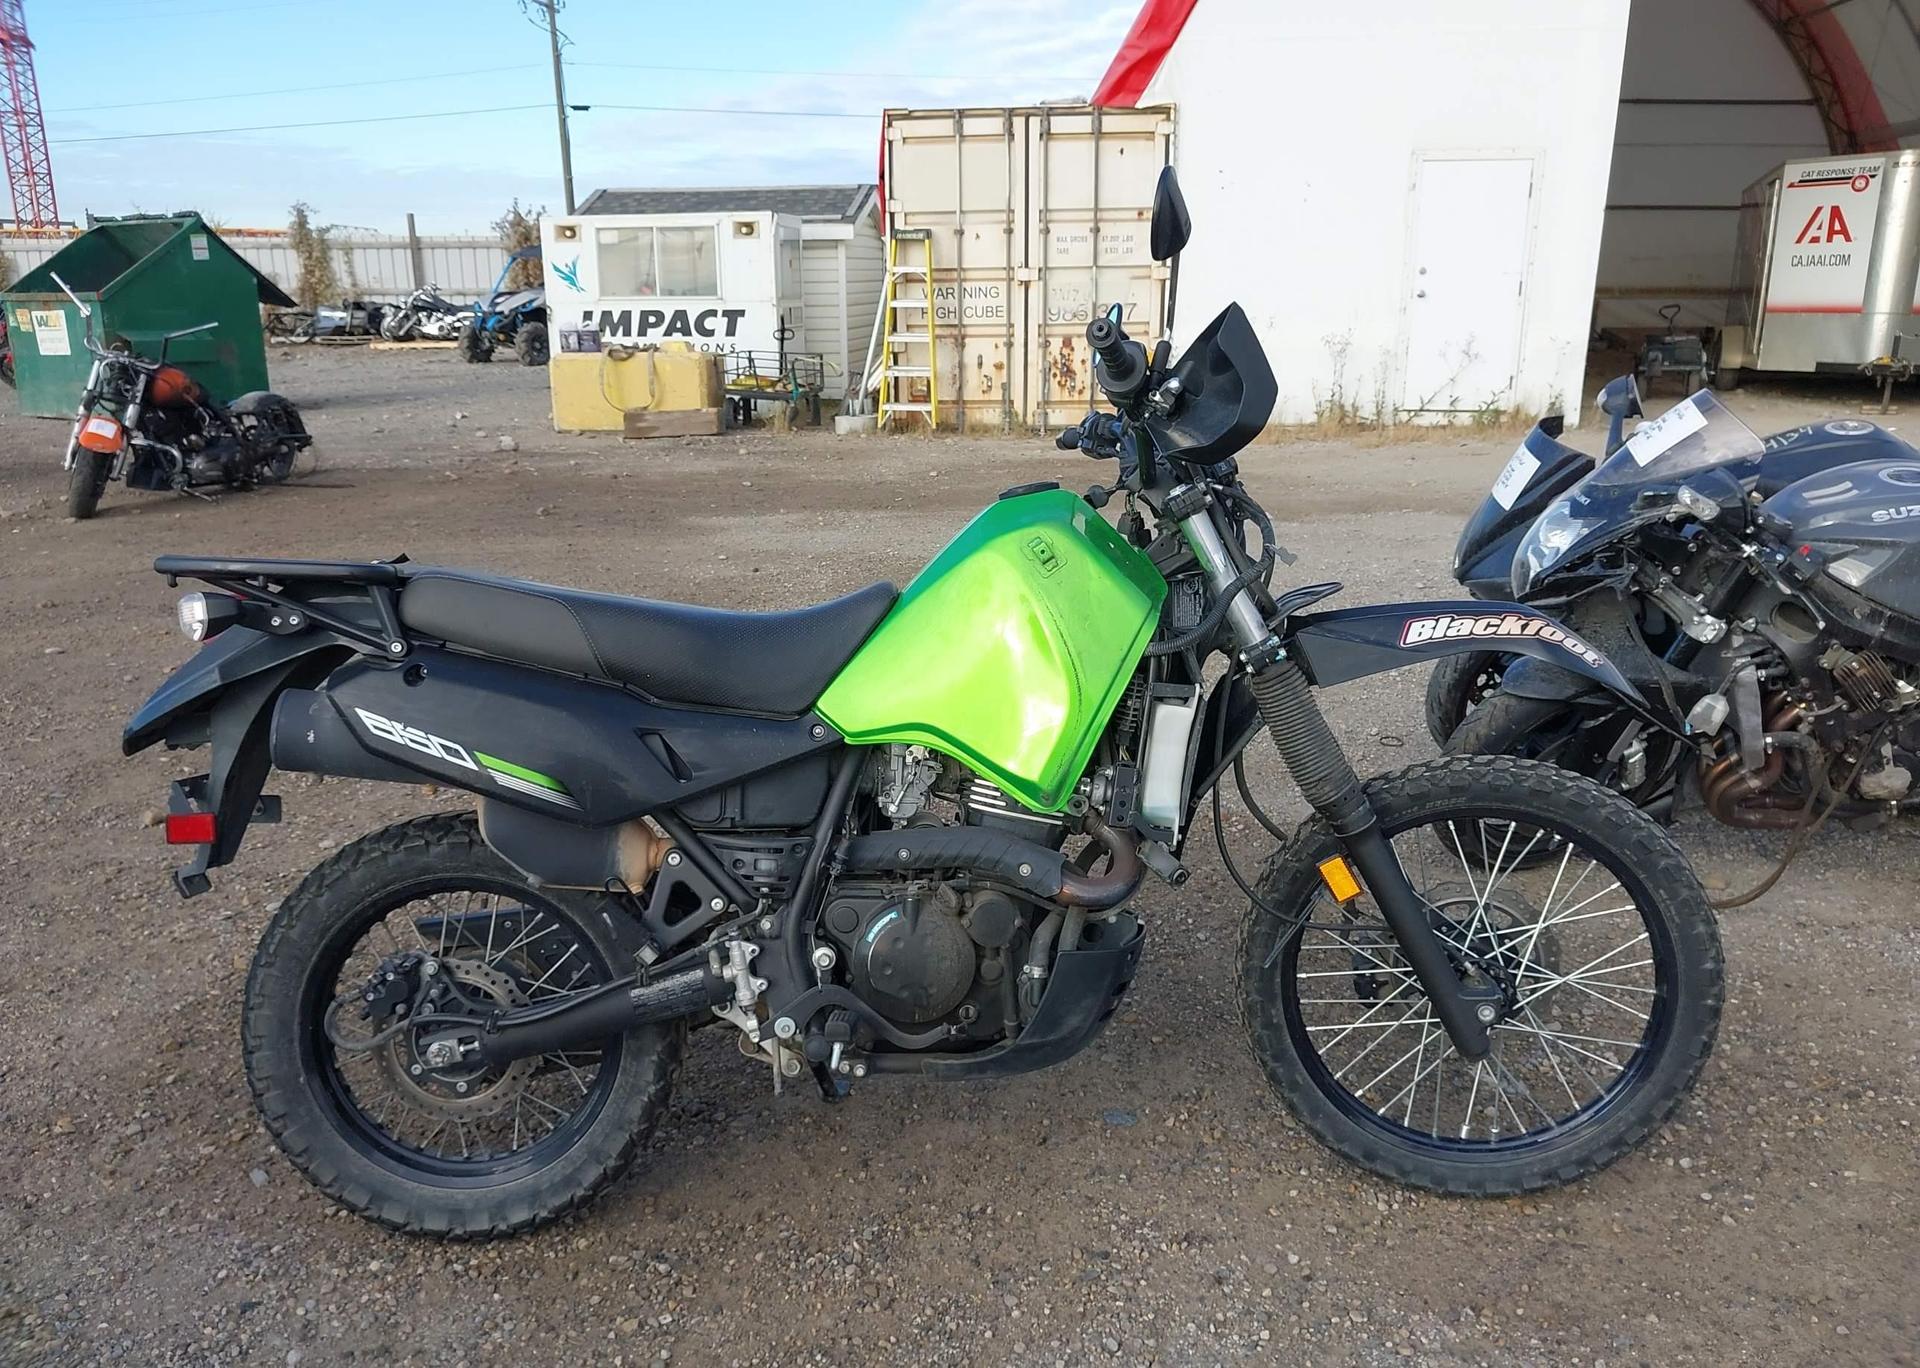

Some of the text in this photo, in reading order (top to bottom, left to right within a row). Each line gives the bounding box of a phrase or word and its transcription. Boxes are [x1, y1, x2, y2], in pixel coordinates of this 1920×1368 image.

[1801, 165, 1881, 178] CAT RESPONSE TEAM
[1791, 253, 1851, 268] CA.IAAI.COM
[921, 305, 1005, 319] HGH CUBE
[1401, 613, 1604, 667] Blackfoot
[354, 707, 479, 771] 650
